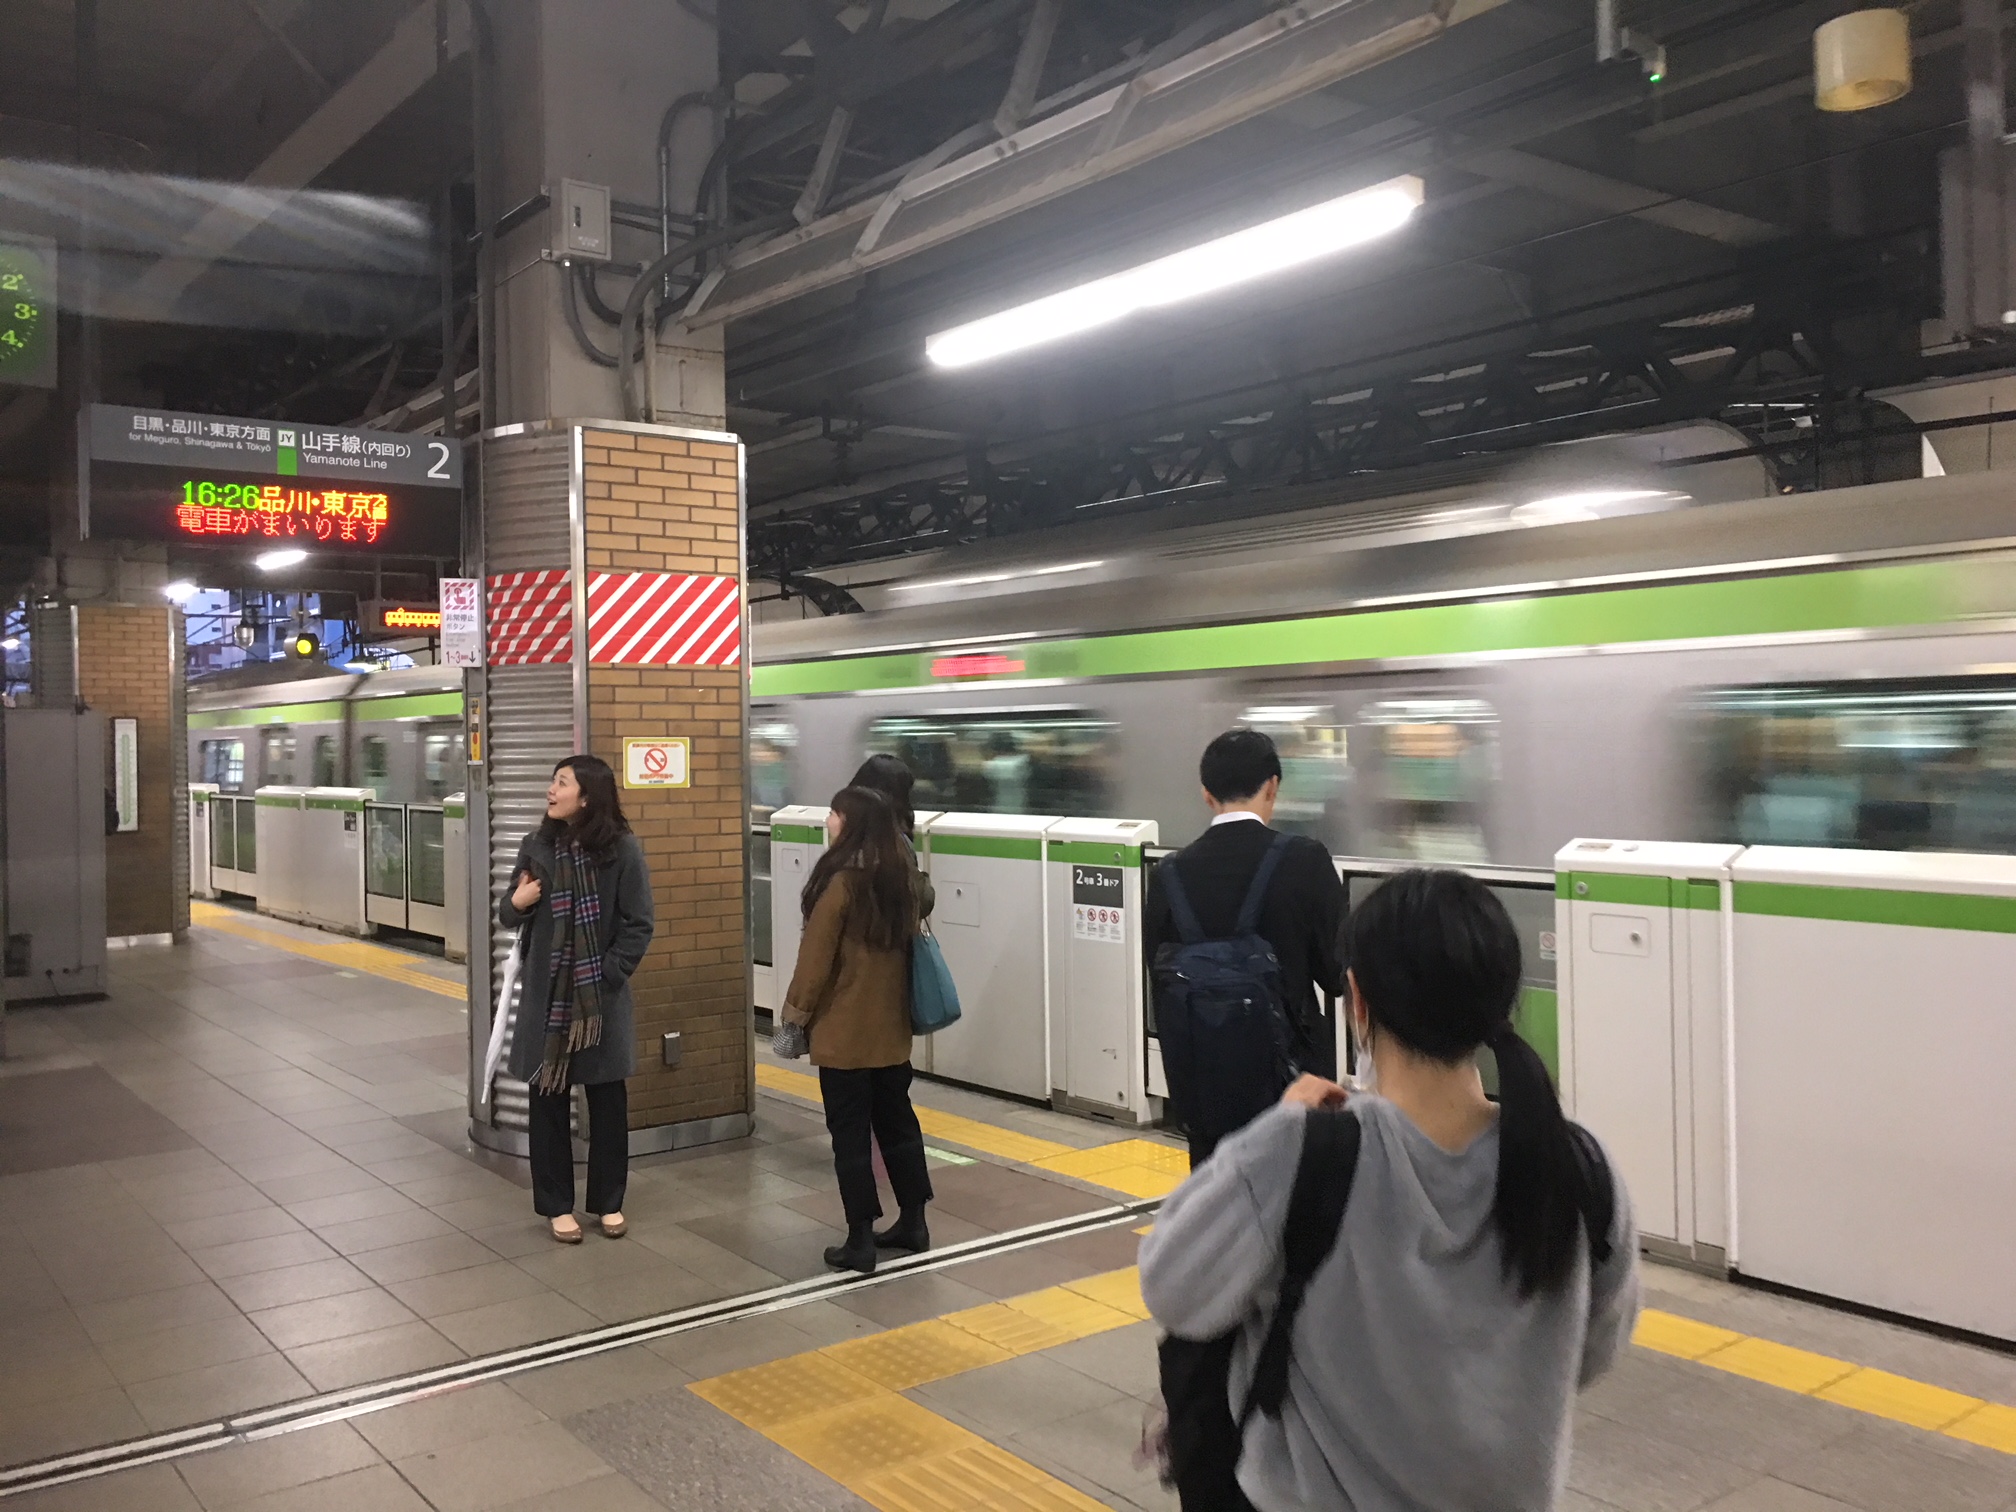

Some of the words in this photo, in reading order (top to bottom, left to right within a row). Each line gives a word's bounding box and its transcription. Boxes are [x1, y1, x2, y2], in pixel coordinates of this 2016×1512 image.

[2, 274, 18, 290] 2
[14, 303, 31, 319] 3
[1, 329, 18, 345] 4
[133, 416, 271, 441] 目黒・品川・東京方面
[128, 432, 141, 441] for
[144, 433, 182, 445] Meguro,
[184, 437, 234, 450] Shinagawa
[236, 442, 243, 450] &
[279, 434, 293, 444] JY
[303, 452, 361, 467] Yamanote
[364, 457, 388, 470] Line
[427, 442, 451, 480] 2
[183, 480, 260, 509] 16:26
[177, 504, 386, 543] 電車がまいります
[446, 613, 474, 622] 非常停止
